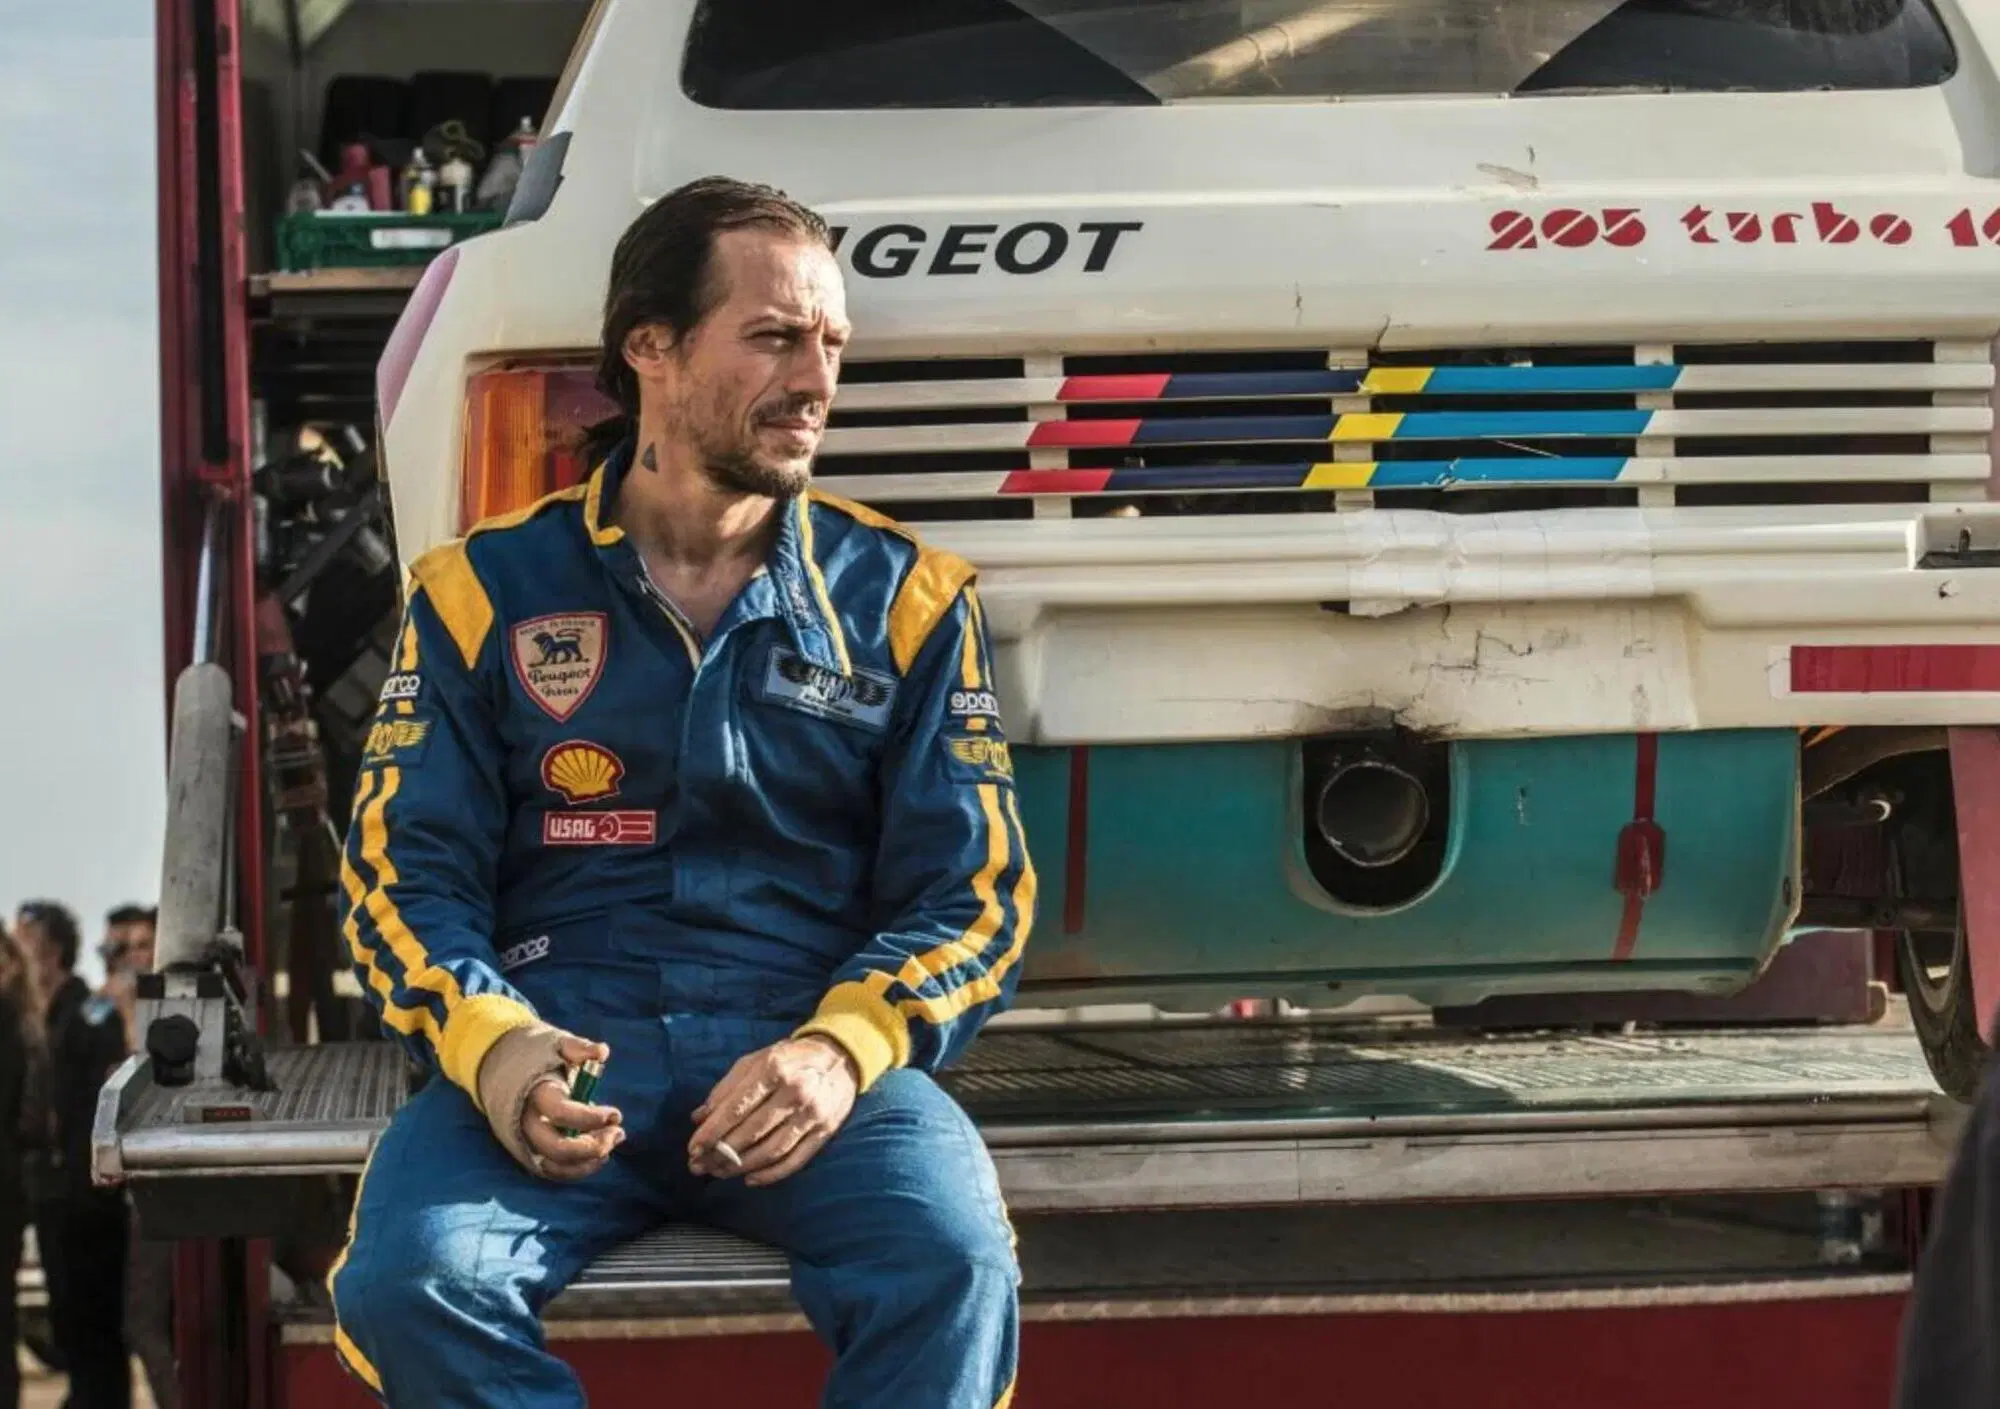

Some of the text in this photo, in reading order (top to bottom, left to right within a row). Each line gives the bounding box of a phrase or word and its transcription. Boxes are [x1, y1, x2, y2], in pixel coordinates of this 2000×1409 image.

[1486, 208, 1647, 250] 205
[1680, 202, 1913, 245] turbo
[381, 675, 421, 700] arco
[550, 818, 597, 838] USAG
